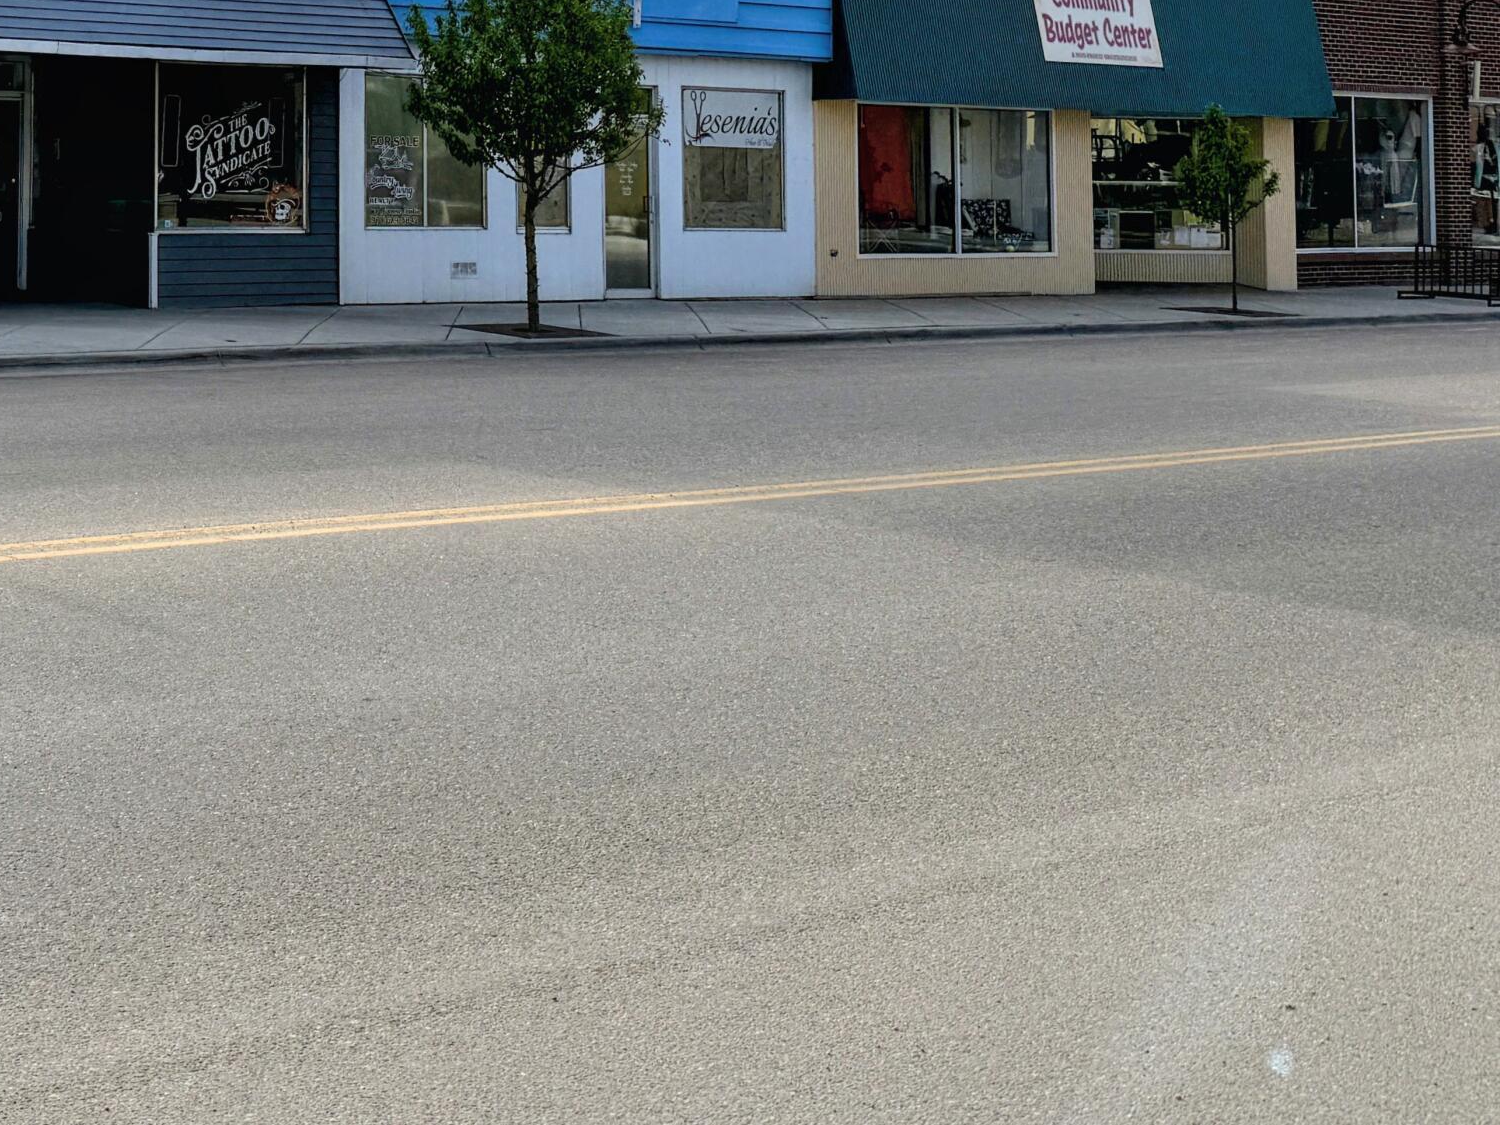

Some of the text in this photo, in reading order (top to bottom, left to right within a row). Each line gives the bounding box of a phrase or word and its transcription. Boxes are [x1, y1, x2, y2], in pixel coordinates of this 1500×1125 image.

[1041, 12, 1153, 50] Budget Center
[227, 113, 248, 133] THE
[370, 134, 420, 148] FOR SALE
[185, 117, 276, 194] TATTOO
[201, 140, 271, 199] SYNDICATE
